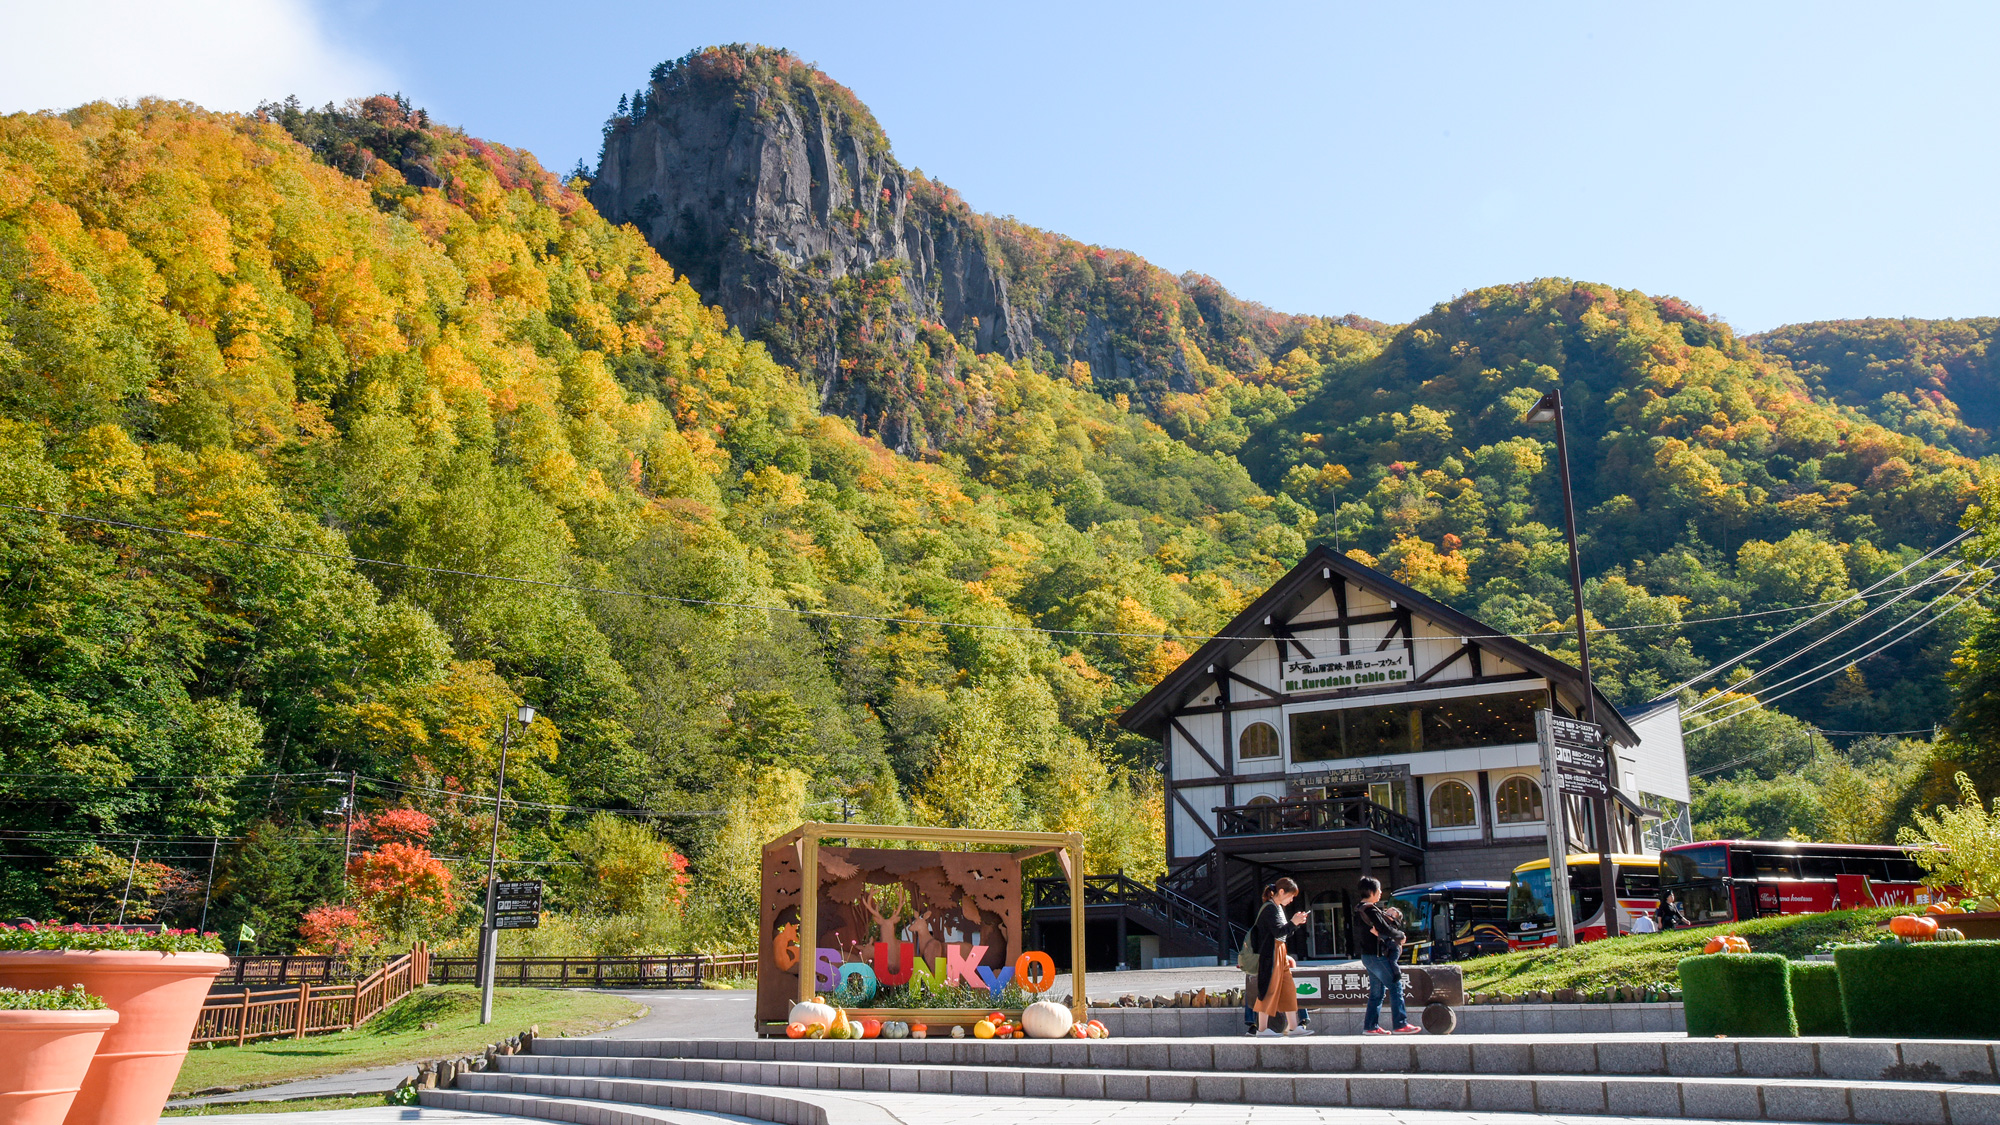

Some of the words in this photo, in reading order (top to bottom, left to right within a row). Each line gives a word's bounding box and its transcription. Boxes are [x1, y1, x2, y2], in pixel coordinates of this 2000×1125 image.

[1354, 671, 1386, 684] Cable
[1388, 669, 1408, 681] Car
[815, 942, 1056, 1003] SOUNKYO
